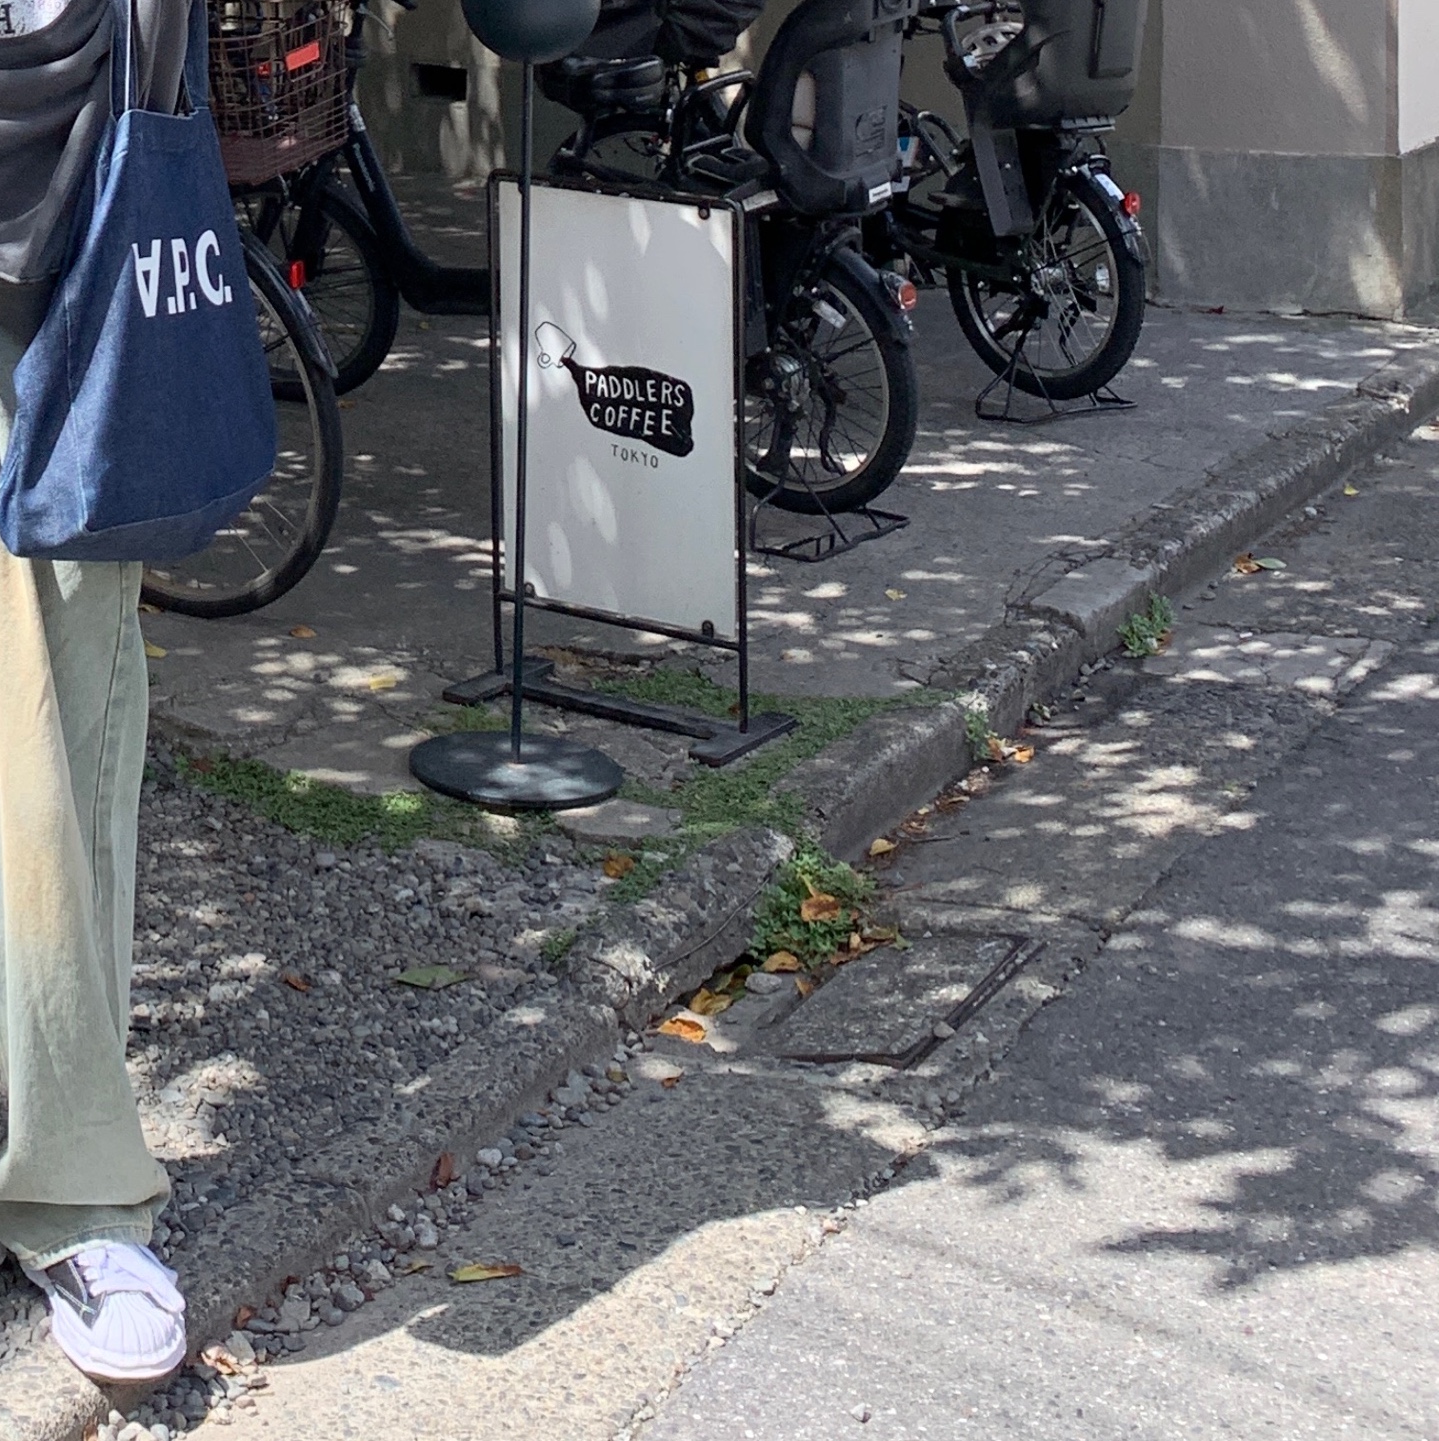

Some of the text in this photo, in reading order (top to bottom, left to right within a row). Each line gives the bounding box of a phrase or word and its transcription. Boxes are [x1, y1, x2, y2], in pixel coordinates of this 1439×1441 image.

[585, 370, 685, 407] PADDLERS
[590, 403, 673, 435] COFFEE
[611, 444, 659, 469] TOKYO
